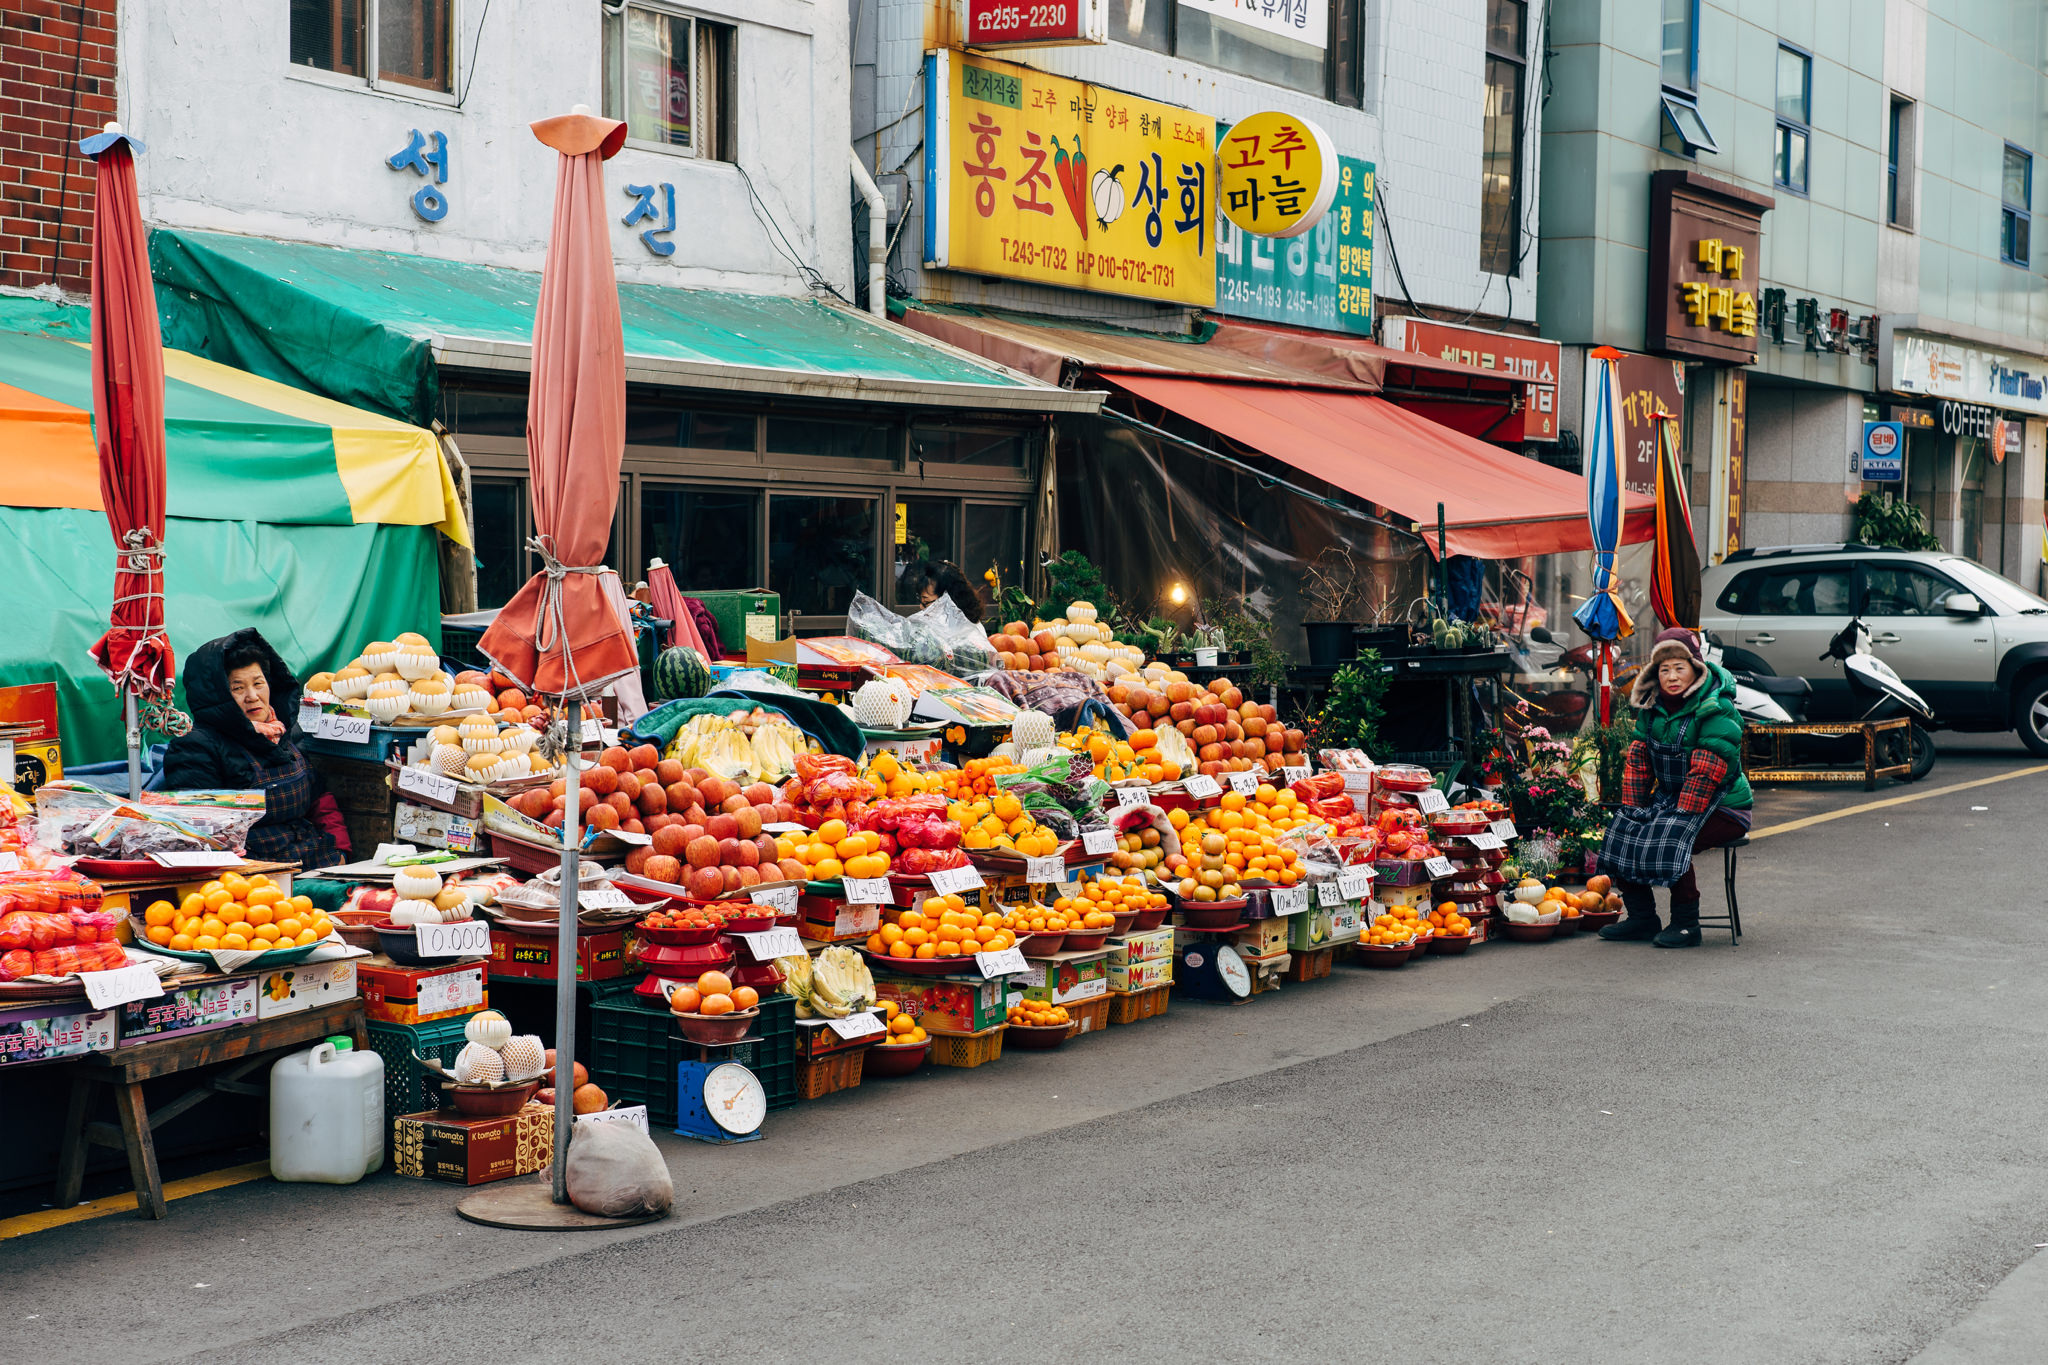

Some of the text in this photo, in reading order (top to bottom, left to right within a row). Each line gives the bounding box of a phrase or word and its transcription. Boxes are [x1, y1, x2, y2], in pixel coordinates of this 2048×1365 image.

[992, 3, 1067, 31] 255-2230
[965, 69, 1019, 106] 산지직송
[1031, 88, 1206, 151] 고추 마늘 양파 참깨 도소매
[1227, 126, 1307, 171] 고추
[384, 128, 677, 257] 성 진
[962, 111, 1206, 258] 홍초 상회
[1226, 175, 1307, 222] 마늘
[1000, 237, 1068, 271] T.243-1732
[1097, 254, 1175, 289] 010-6712-1731
[1338, 243, 1372, 279] 방한복
[1337, 282, 1372, 318] 장갑류
[1682, 281, 1758, 338] 커피숍
[1943, 400, 1991, 440] COFFEE
[1637, 440, 1653, 463] 2F
[1872, 433, 1894, 446] 담배
[438, 1131, 464, 1141] tomato
[478, 1129, 501, 1139] tomato
